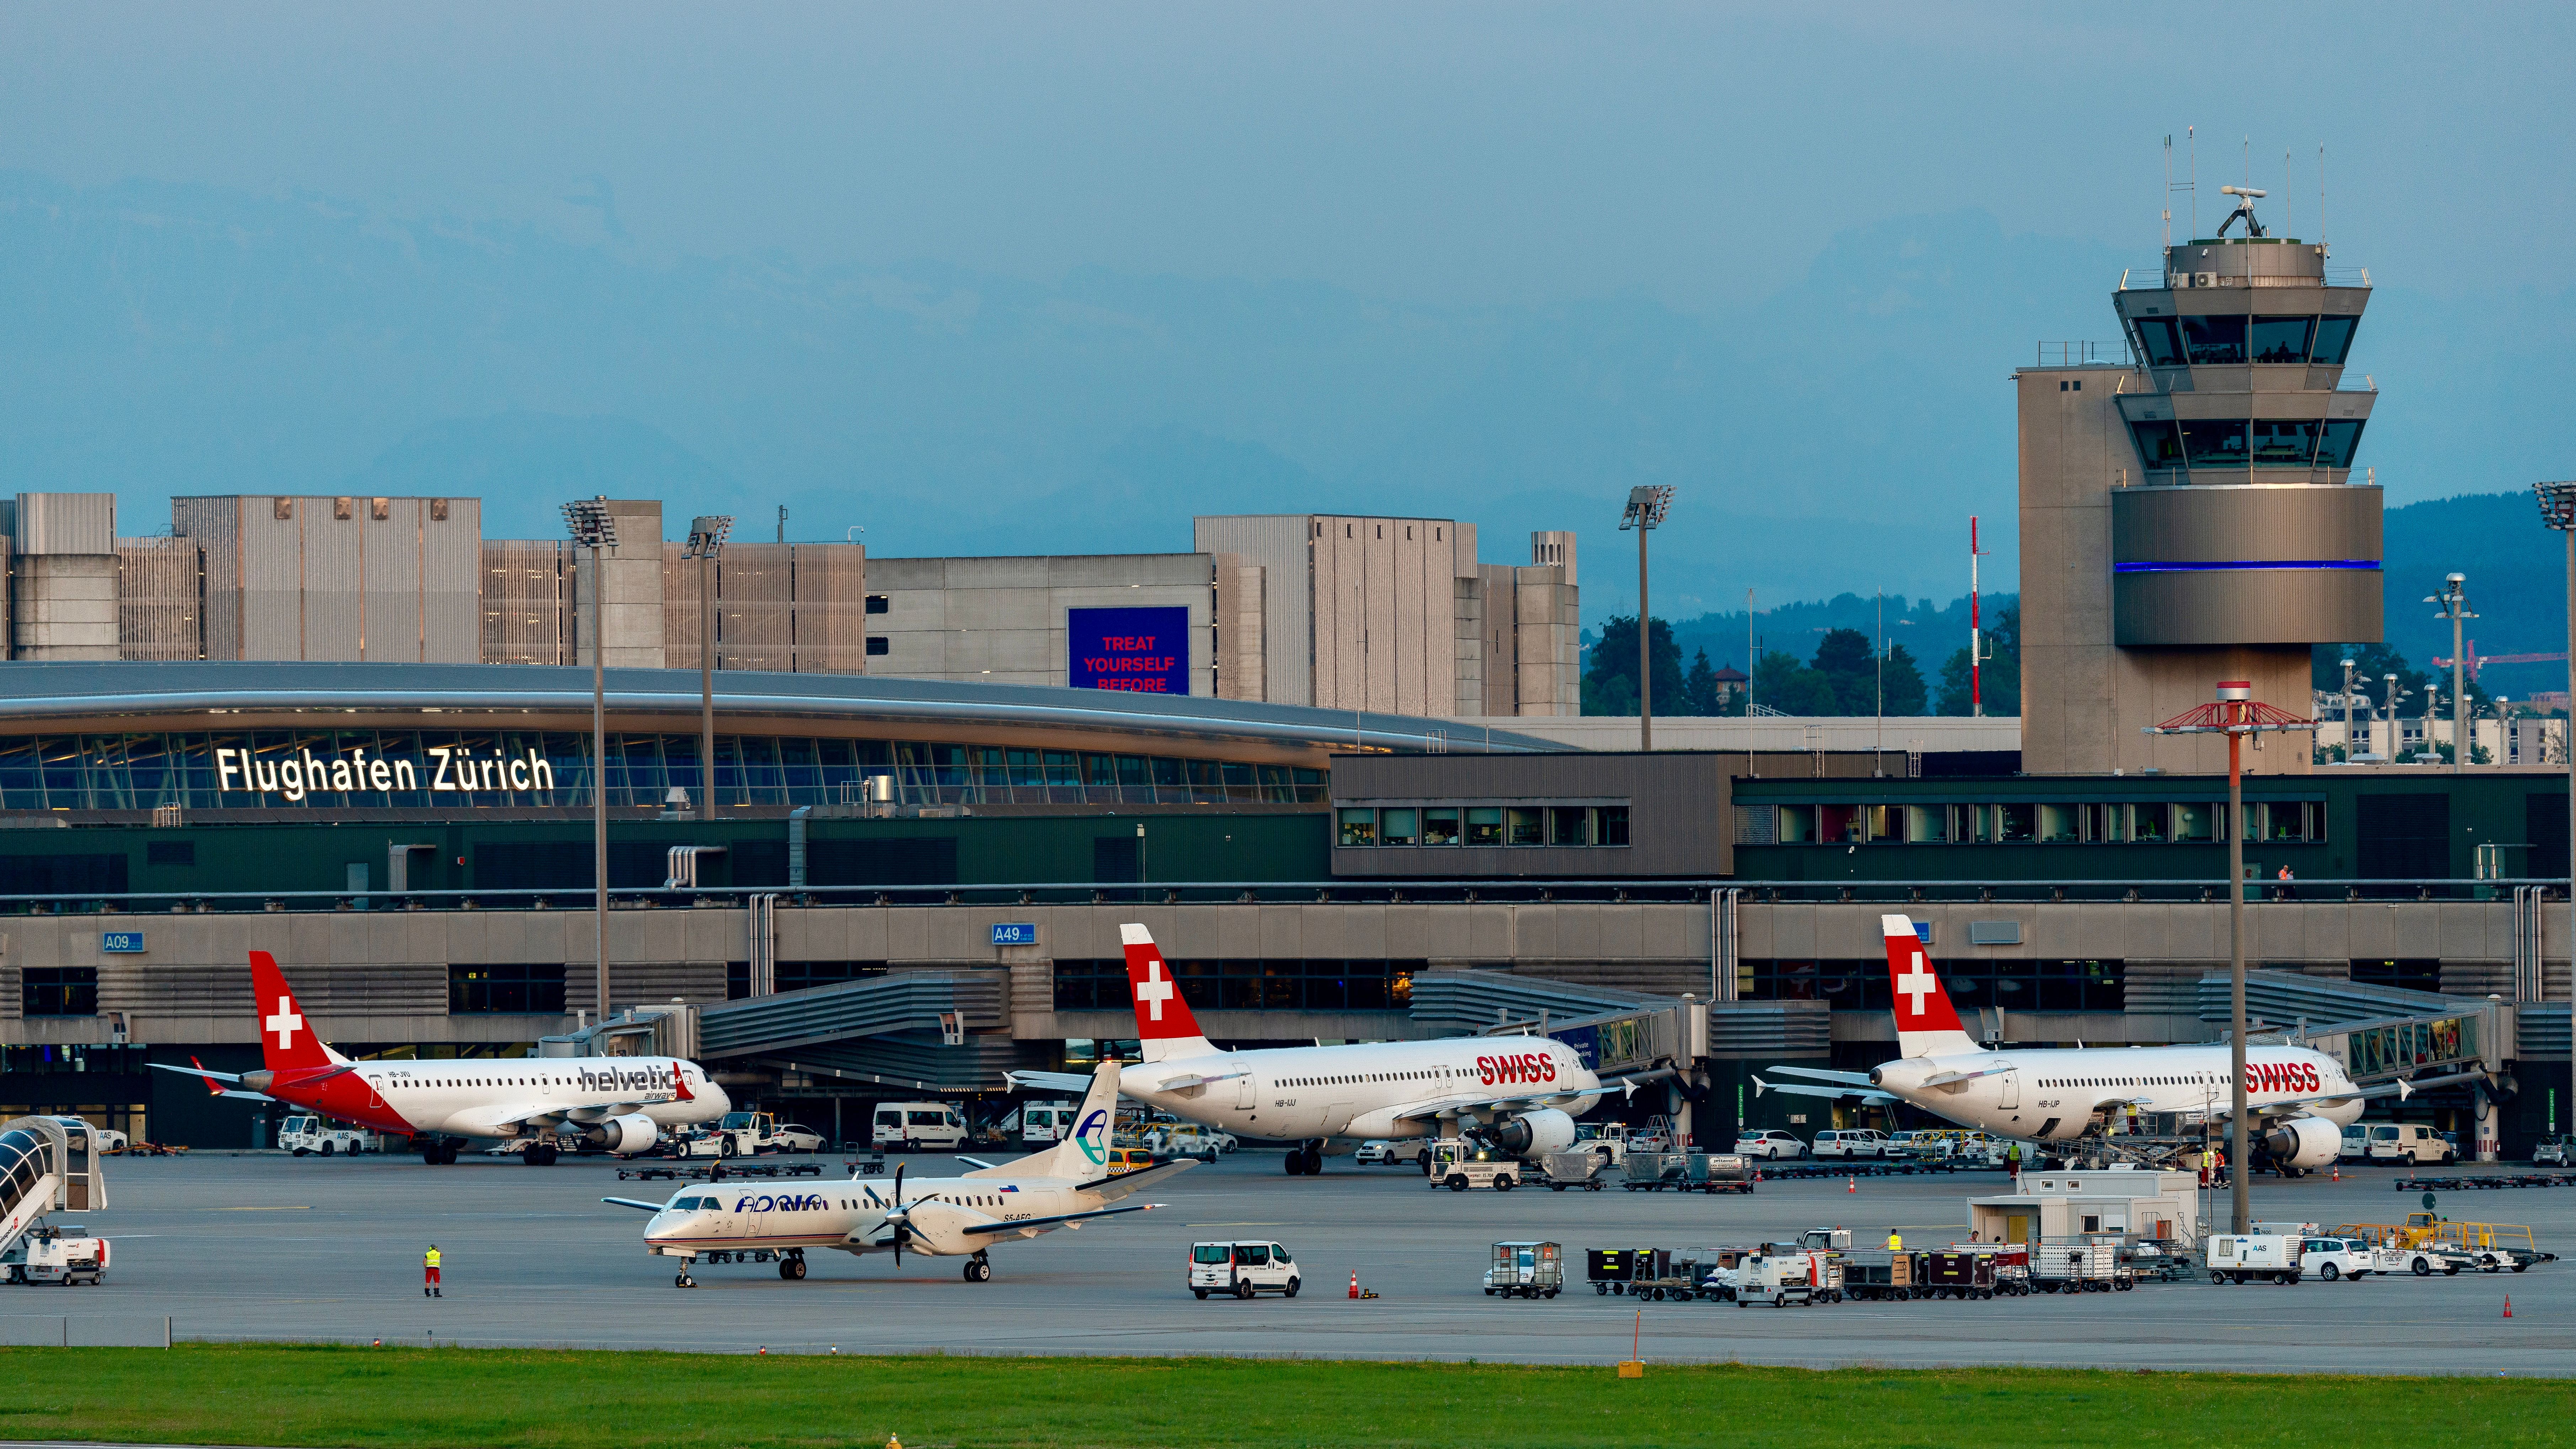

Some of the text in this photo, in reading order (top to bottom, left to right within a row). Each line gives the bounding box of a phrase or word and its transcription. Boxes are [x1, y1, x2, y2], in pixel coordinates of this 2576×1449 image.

[1102, 636, 1156, 651] TREAT
[1084, 657, 1175, 672] YOURSELF
[1098, 678, 1167, 692] BEFORE
[217, 748, 554, 801] Flughafen Zürich
[994, 927, 1020, 941] A49
[105, 935, 129, 949] A09
[1477, 1053, 1556, 1086] SWISS
[579, 1066, 677, 1091] helvetic
[2245, 1063, 2320, 1093] SWISS
[644, 1091, 675, 1099] airways
[1275, 1099, 1296, 1107] HB-IJJ
[734, 1194, 823, 1213] ADRIA
